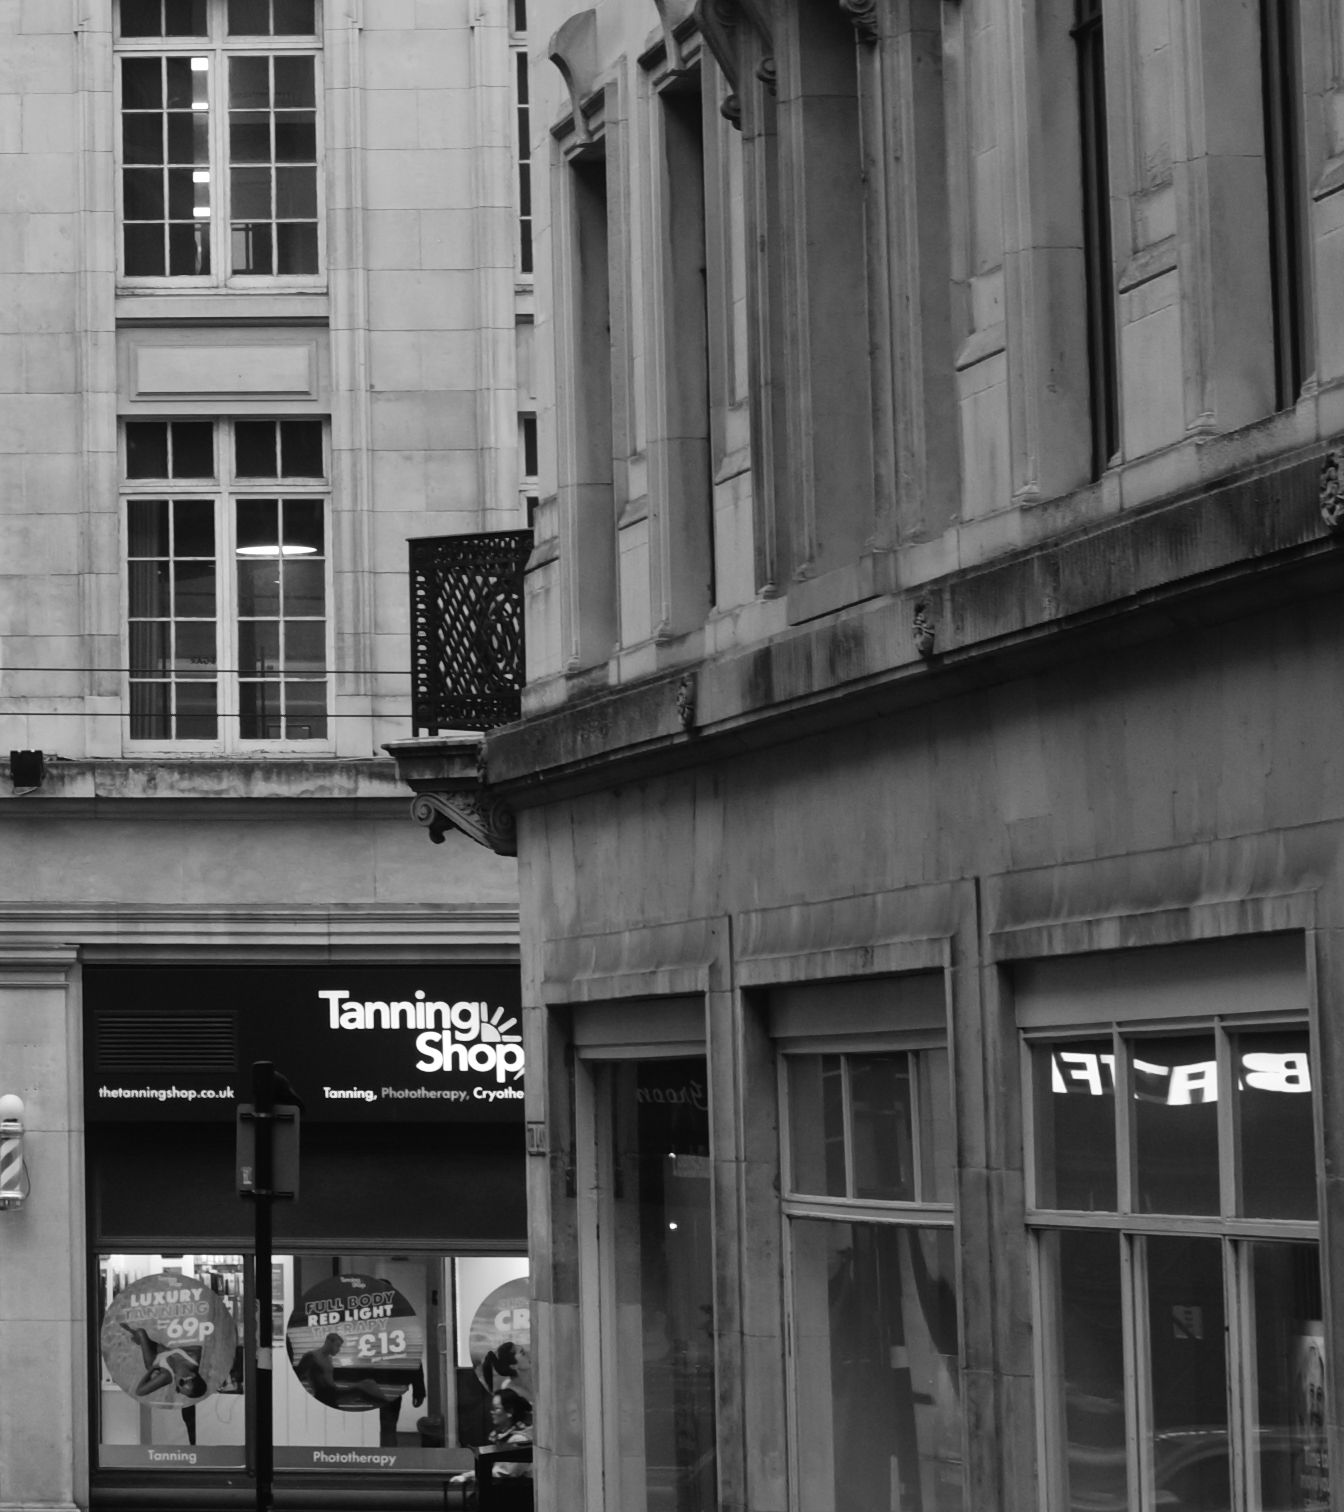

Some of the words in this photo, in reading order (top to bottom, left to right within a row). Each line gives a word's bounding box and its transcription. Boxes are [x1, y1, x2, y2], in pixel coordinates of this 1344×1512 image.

[318, 989, 480, 1042] Tanning
[415, 1029, 525, 1084] Shop
[98, 1084, 236, 1102] thetanningshop.co.uk
[322, 1086, 378, 1102] Tanning,
[381, 1086, 470, 1102] Phototherapy,
[472, 1086, 525, 1102] Cryothe
[130, 1288, 203, 1307] LUXURY
[305, 1297, 345, 1315] FULL
[347, 1290, 396, 1309] BODY
[123, 1301, 210, 1321] TANNING
[307, 1311, 341, 1327] RED
[344, 1304, 394, 1322] LIGHT
[494, 1310, 530, 1331] CR
[167, 1317, 215, 1342] 69p
[358, 1329, 406, 1357] £13
[147, 1449, 198, 1465] Tanning
[312, 1451, 398, 1467] Phototherapy
